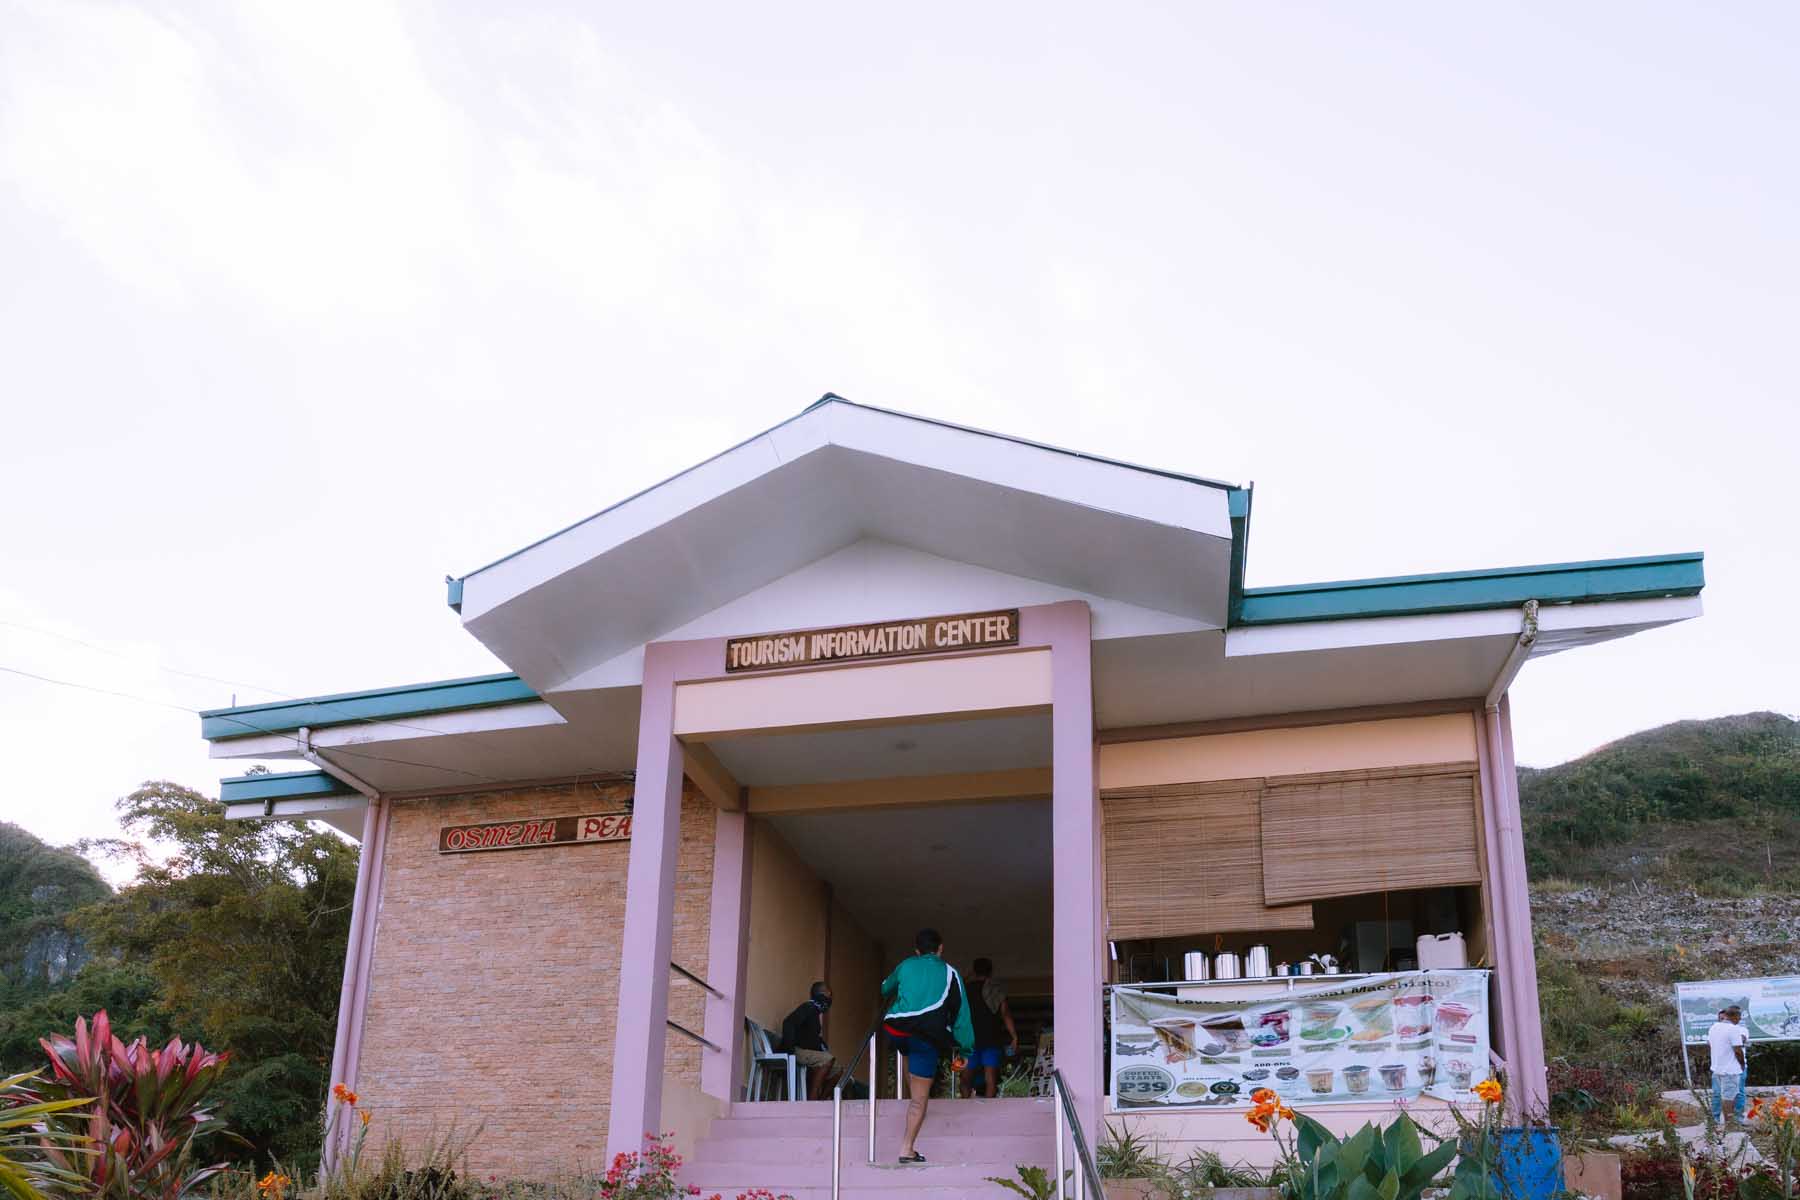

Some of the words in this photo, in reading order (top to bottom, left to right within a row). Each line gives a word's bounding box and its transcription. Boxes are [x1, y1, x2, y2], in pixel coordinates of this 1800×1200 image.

[730, 636, 806, 668] TOURISM
[810, 623, 927, 660] INFORMATION
[934, 615, 1011, 647] CENTER
[583, 815, 633, 839] PEA
